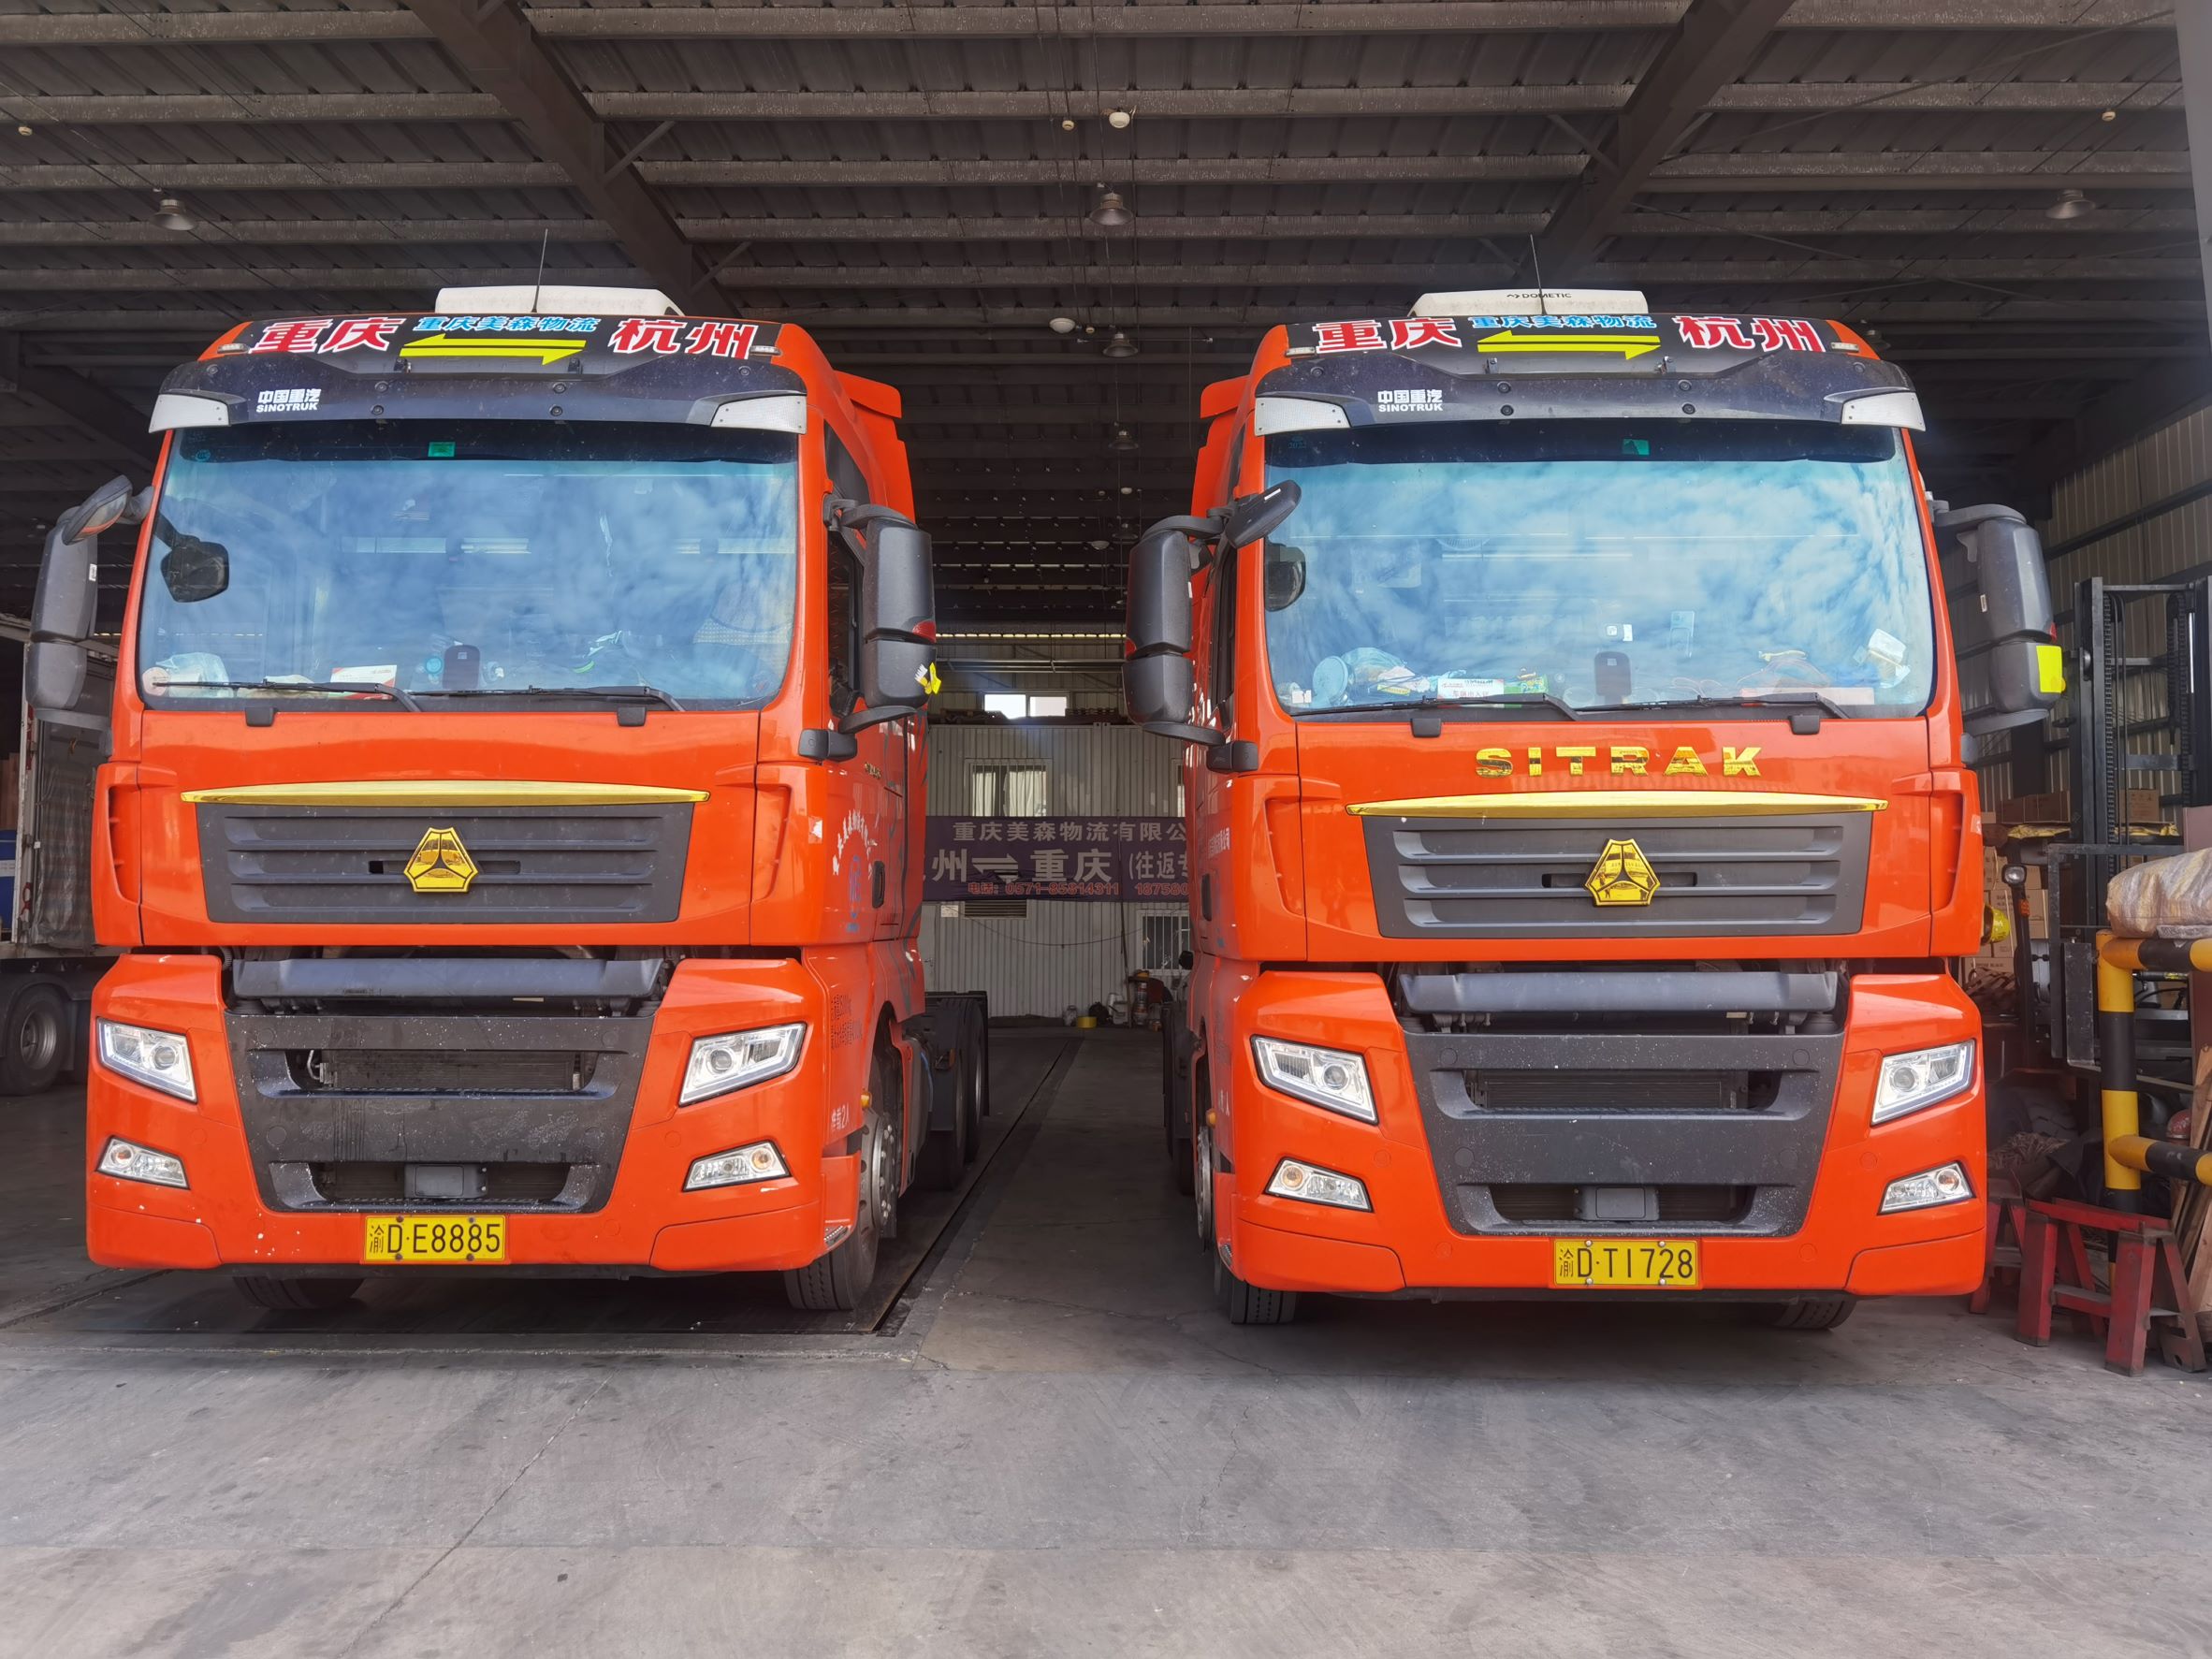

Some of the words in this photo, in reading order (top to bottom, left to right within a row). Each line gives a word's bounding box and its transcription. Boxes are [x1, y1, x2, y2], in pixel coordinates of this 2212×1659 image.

[413, 316, 601, 331] 重庆美森物流
[1467, 315, 1657, 329] 重庆美森物流
[1672, 315, 1826, 353] 杭州
[248, 317, 406, 354] 重庆
[608, 318, 758, 360] 杭州
[1312, 317, 1463, 354] 重庆
[256, 402, 318, 413] SINOTRUK
[257, 388, 321, 404] 中国重汽
[1377, 389, 1443, 404] 中国重汽
[1378, 403, 1444, 413] SINOTRUK
[1476, 746, 1763, 778] SITRAK
[1029, 848, 1113, 883] 重庆
